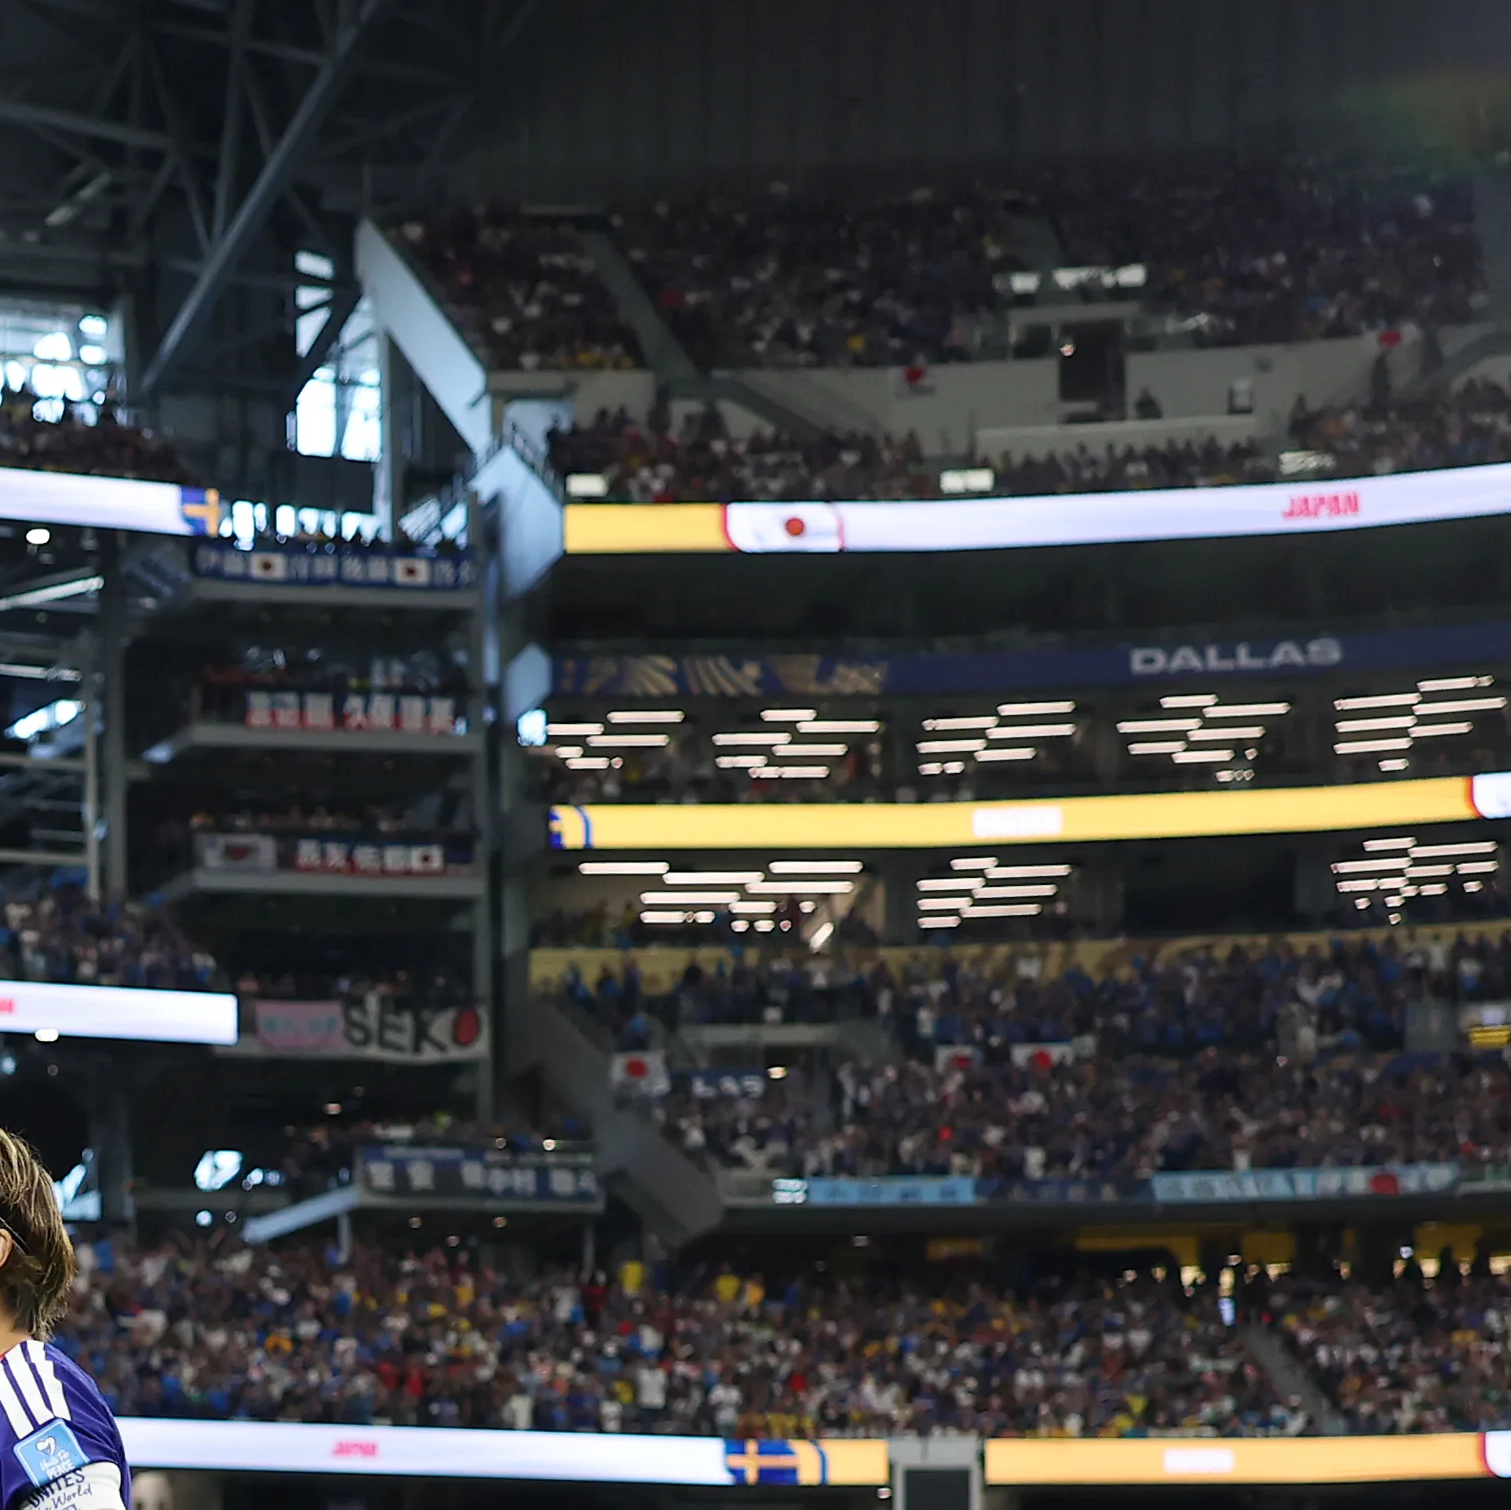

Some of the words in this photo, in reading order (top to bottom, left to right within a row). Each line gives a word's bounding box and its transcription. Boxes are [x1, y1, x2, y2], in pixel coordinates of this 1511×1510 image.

[1282, 492, 1361, 519] JAPAN
[1130, 637, 1344, 675] DALLAS
[52, 1483, 93, 1509] World
